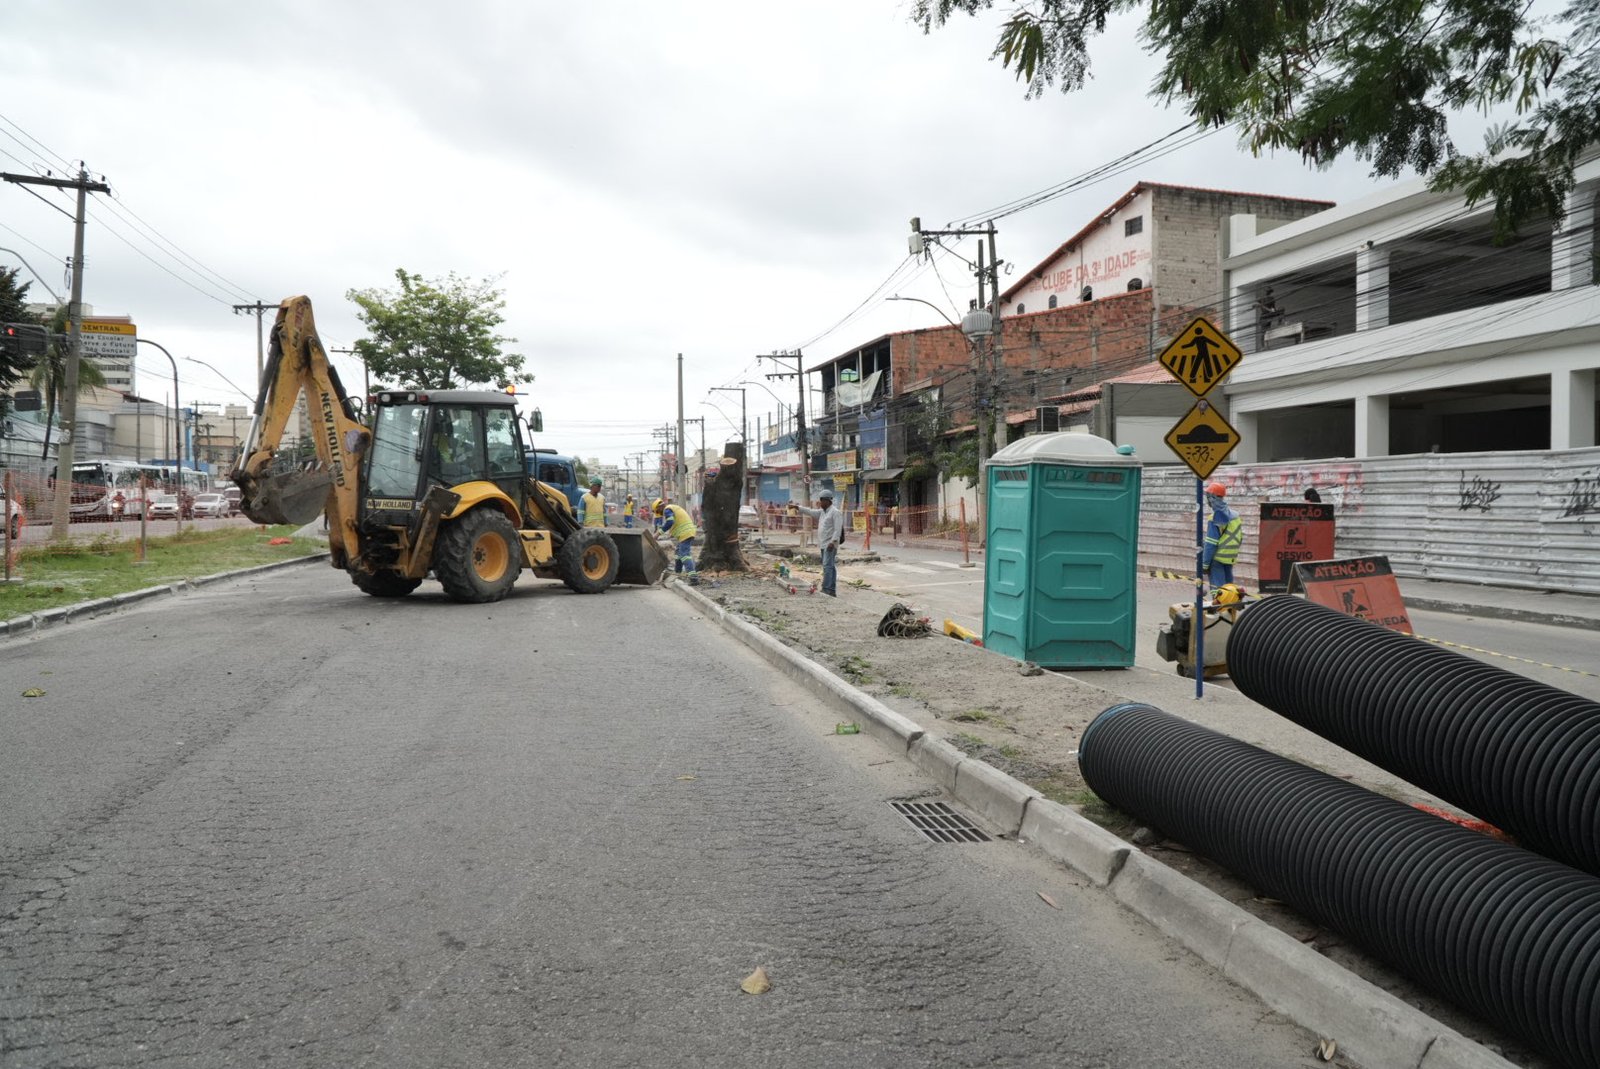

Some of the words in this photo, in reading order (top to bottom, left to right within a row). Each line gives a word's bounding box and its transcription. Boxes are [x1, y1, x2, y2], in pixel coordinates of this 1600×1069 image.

[1042, 268, 1072, 290] CLUBE
[1076, 264, 1089, 281] DA
[1105, 250, 1137, 273] IDADE
[82, 324, 120, 332] SEMTRAN
[321, 392, 334, 423] NEW
[382, 500, 411, 509] HOLLAND
[1272, 506, 1322, 519] ATENÇÃO
[1276, 551, 1313, 560] DESVIO
[1314, 560, 1376, 578] ATENÇÃO
